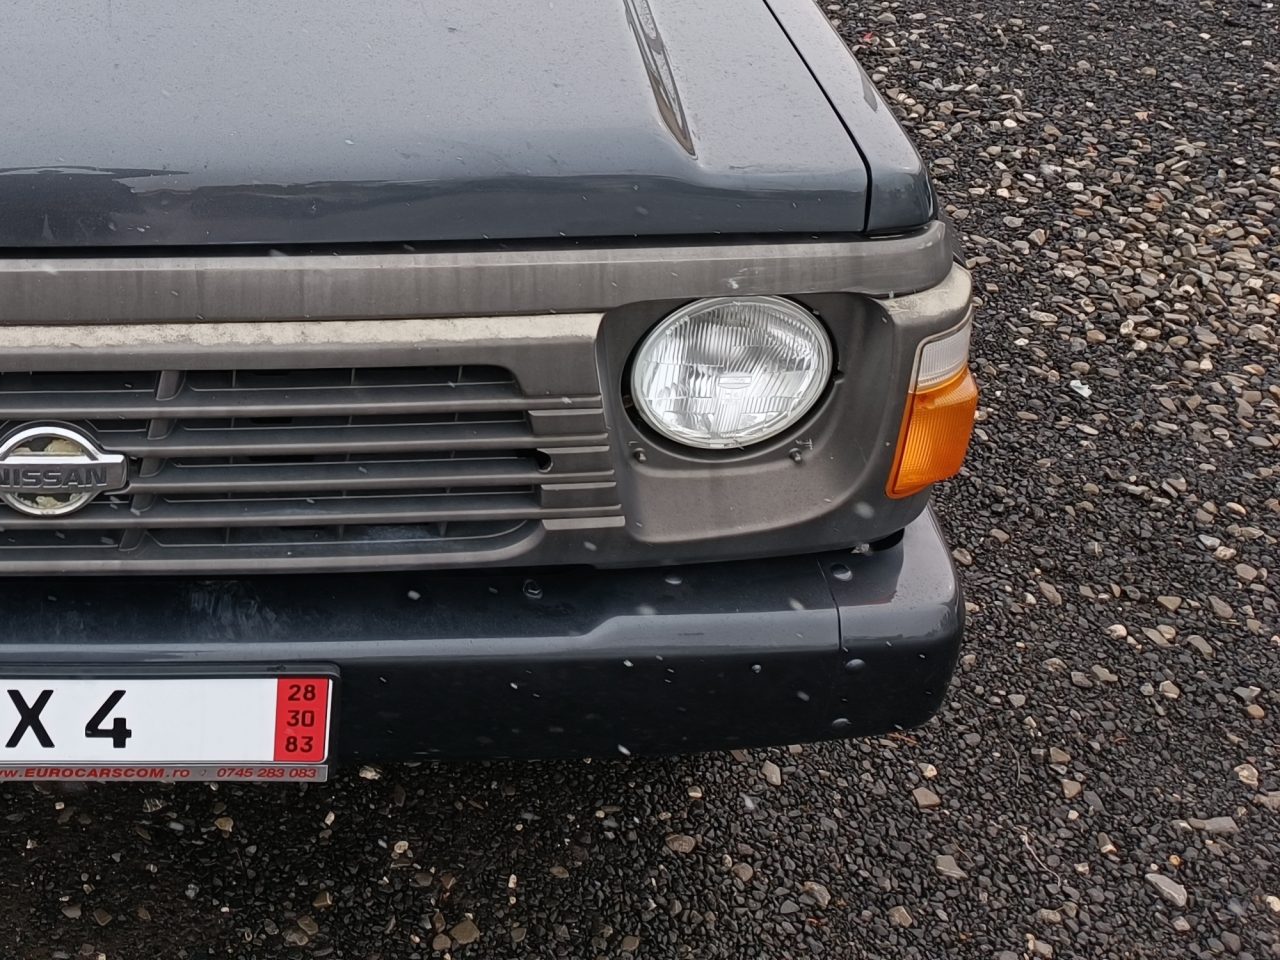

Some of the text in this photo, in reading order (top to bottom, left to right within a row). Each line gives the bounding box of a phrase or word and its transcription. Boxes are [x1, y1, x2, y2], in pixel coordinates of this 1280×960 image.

[287, 684, 316, 702] 28
[286, 710, 315, 727] 30
[284, 736, 314, 753] 83
[216, 768, 253, 778] 0745
[257, 768, 286, 778] 283
[289, 768, 317, 778] 083
